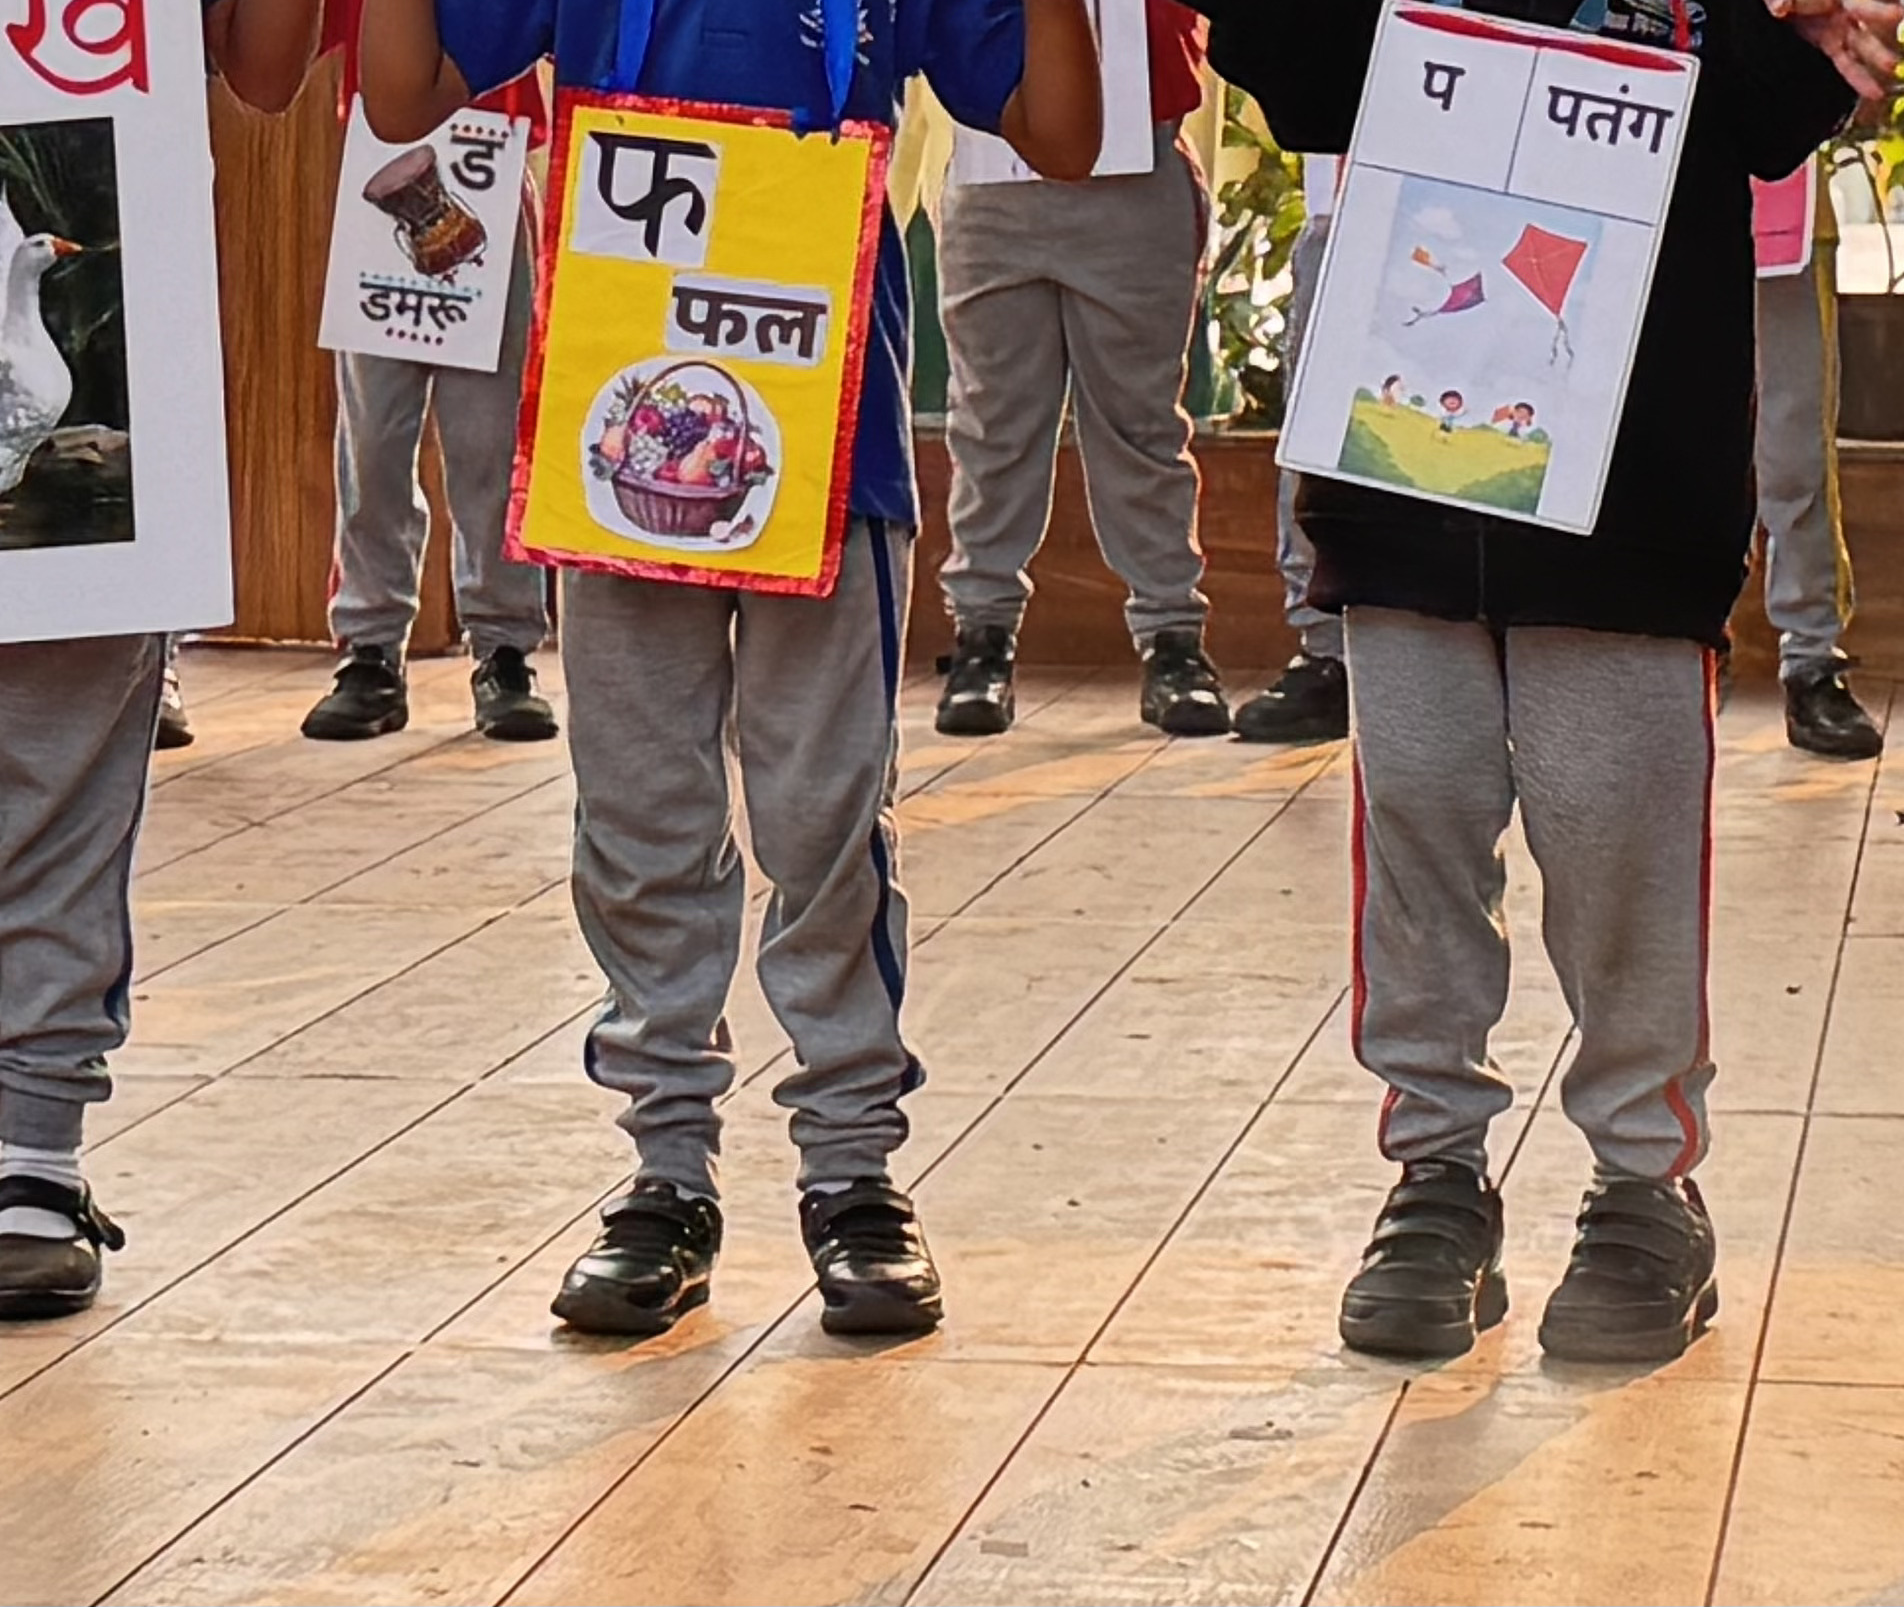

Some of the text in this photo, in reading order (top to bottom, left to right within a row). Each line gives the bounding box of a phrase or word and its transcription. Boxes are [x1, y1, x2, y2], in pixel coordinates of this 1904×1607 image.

[1423, 61, 1674, 154] प पतंग
[449, 132, 507, 191] ड
[588, 131, 718, 258] फ
[671, 286, 827, 358] फल
